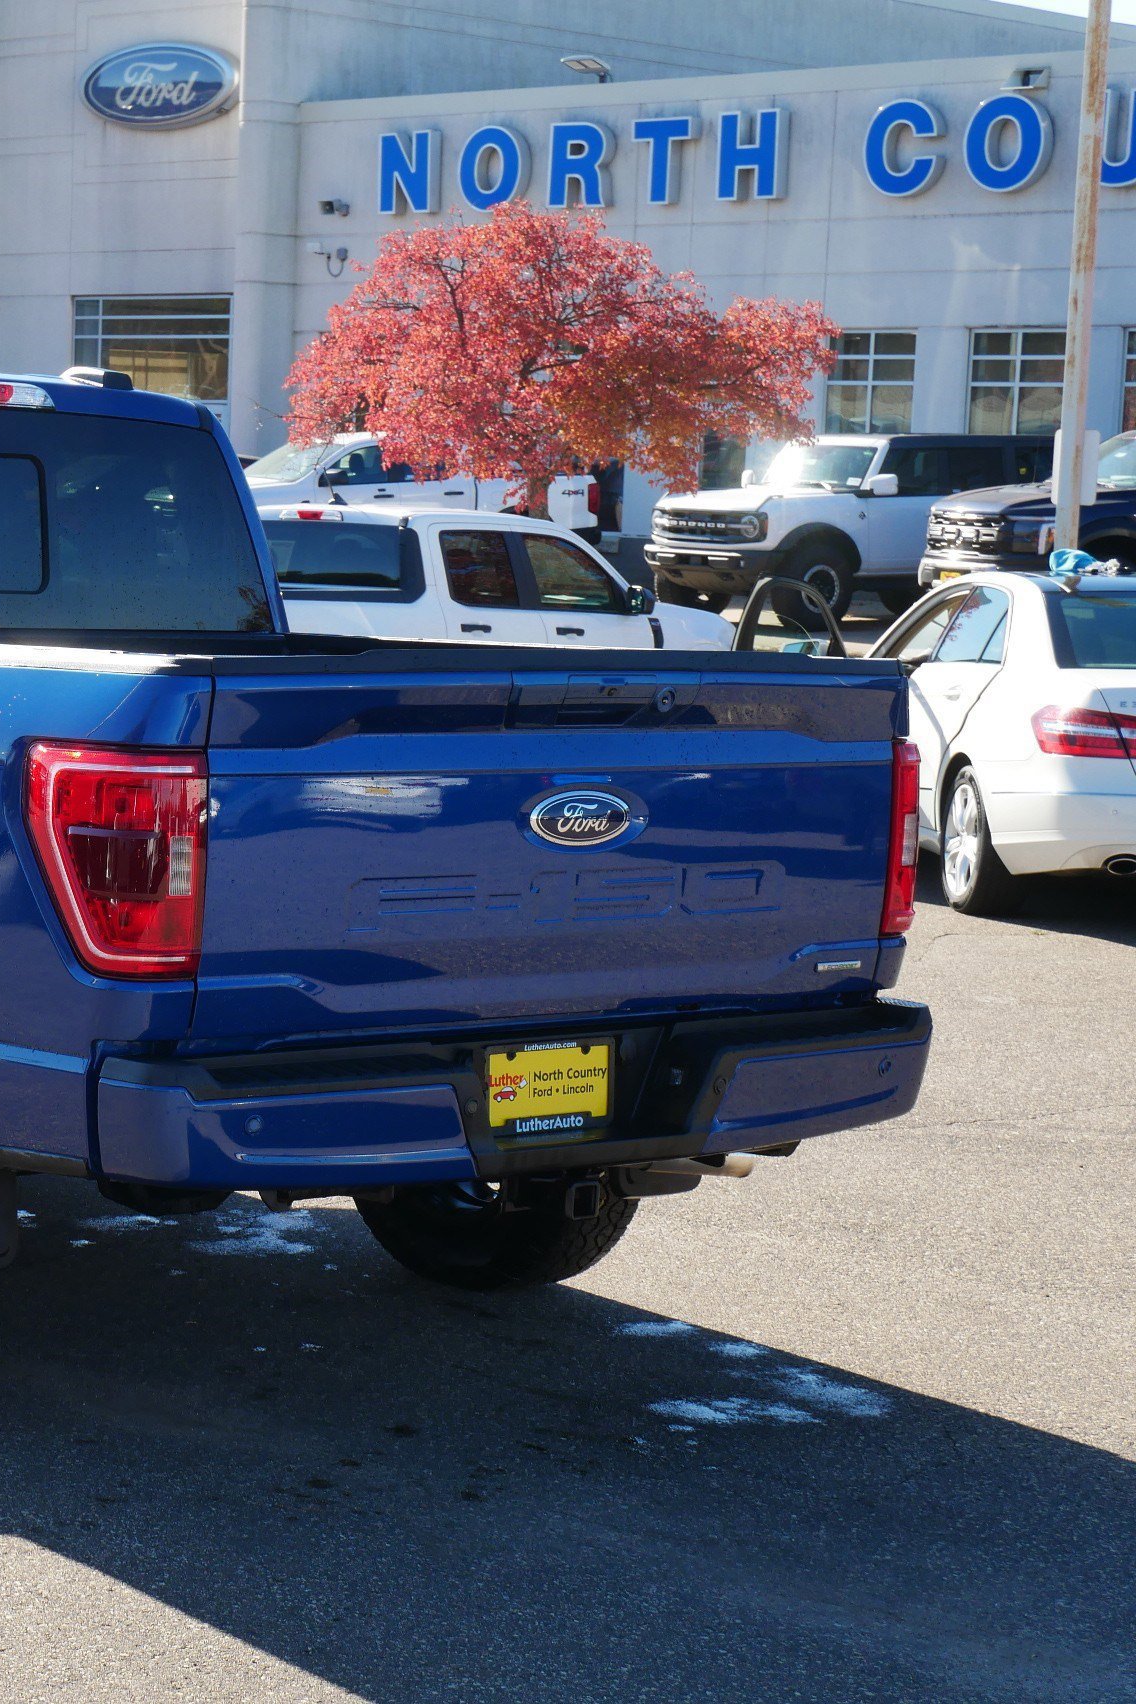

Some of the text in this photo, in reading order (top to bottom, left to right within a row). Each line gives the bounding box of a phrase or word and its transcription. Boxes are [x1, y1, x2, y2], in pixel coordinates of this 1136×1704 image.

[115, 61, 199, 110] Ford
[377, 107, 786, 215] NORTH
[557, 802, 610, 833] Ford
[524, 1041, 577, 1051] LutherAuto.com
[488, 1073, 524, 1087] Luther
[533, 1067, 607, 1082] North Country
[533, 1083, 594, 1098] Ford Lincoln
[516, 1115, 584, 1133] LutherAuto
